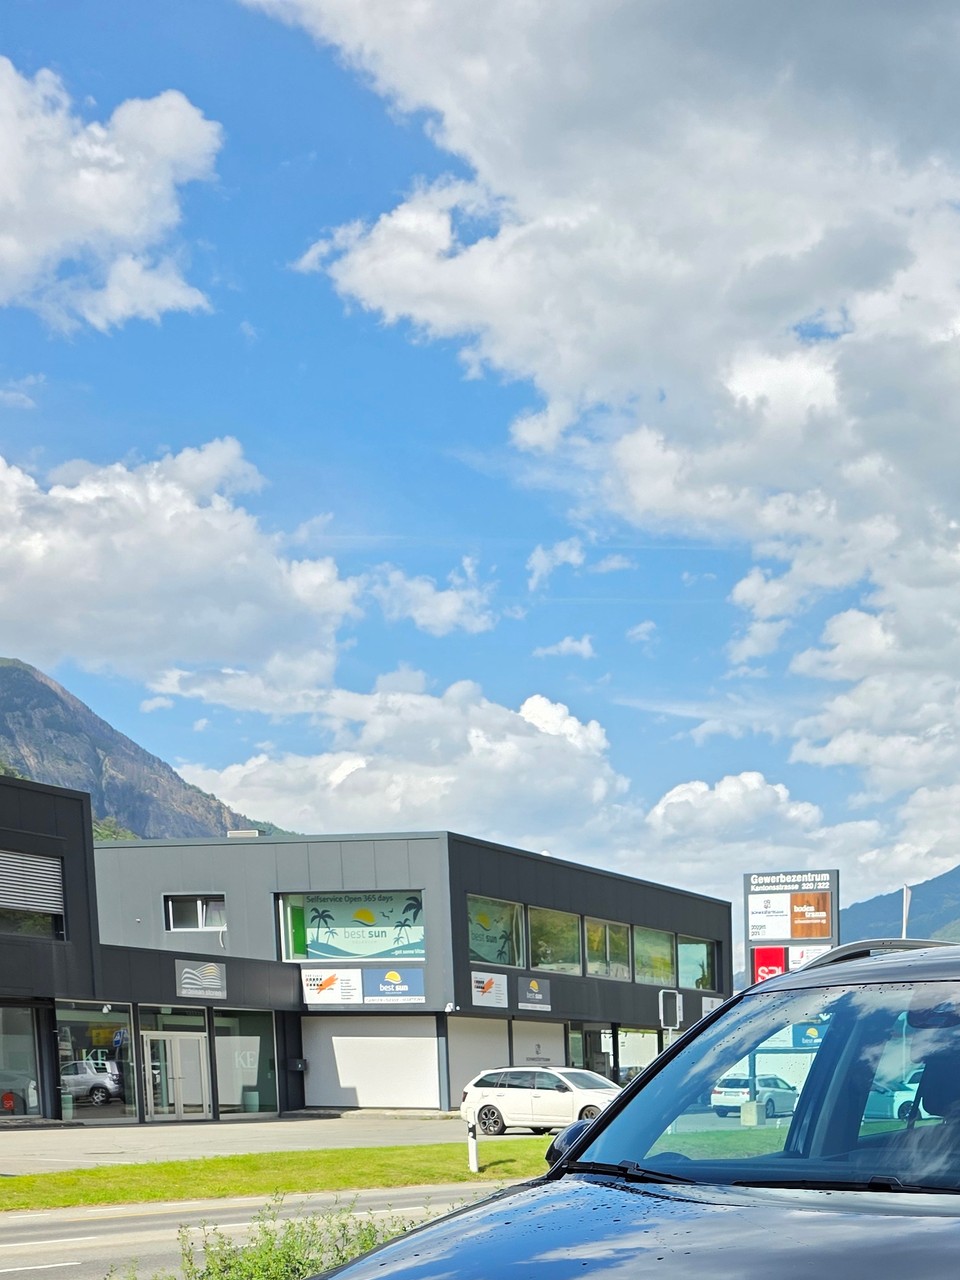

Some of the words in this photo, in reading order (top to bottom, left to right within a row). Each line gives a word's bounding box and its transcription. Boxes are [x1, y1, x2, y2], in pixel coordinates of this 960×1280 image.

[750, 873, 830, 884] Gewerbezentrum
[306, 895, 344, 904] Selfservice
[345, 895, 364, 904] Open
[364, 894, 377, 903] 365
[377, 894, 394, 903] days
[343, 928, 366, 939] best
[368, 929, 387, 938] sun
[486, 934, 497, 944] sun
[379, 983, 396, 991] best
[396, 984, 409, 992] sun
